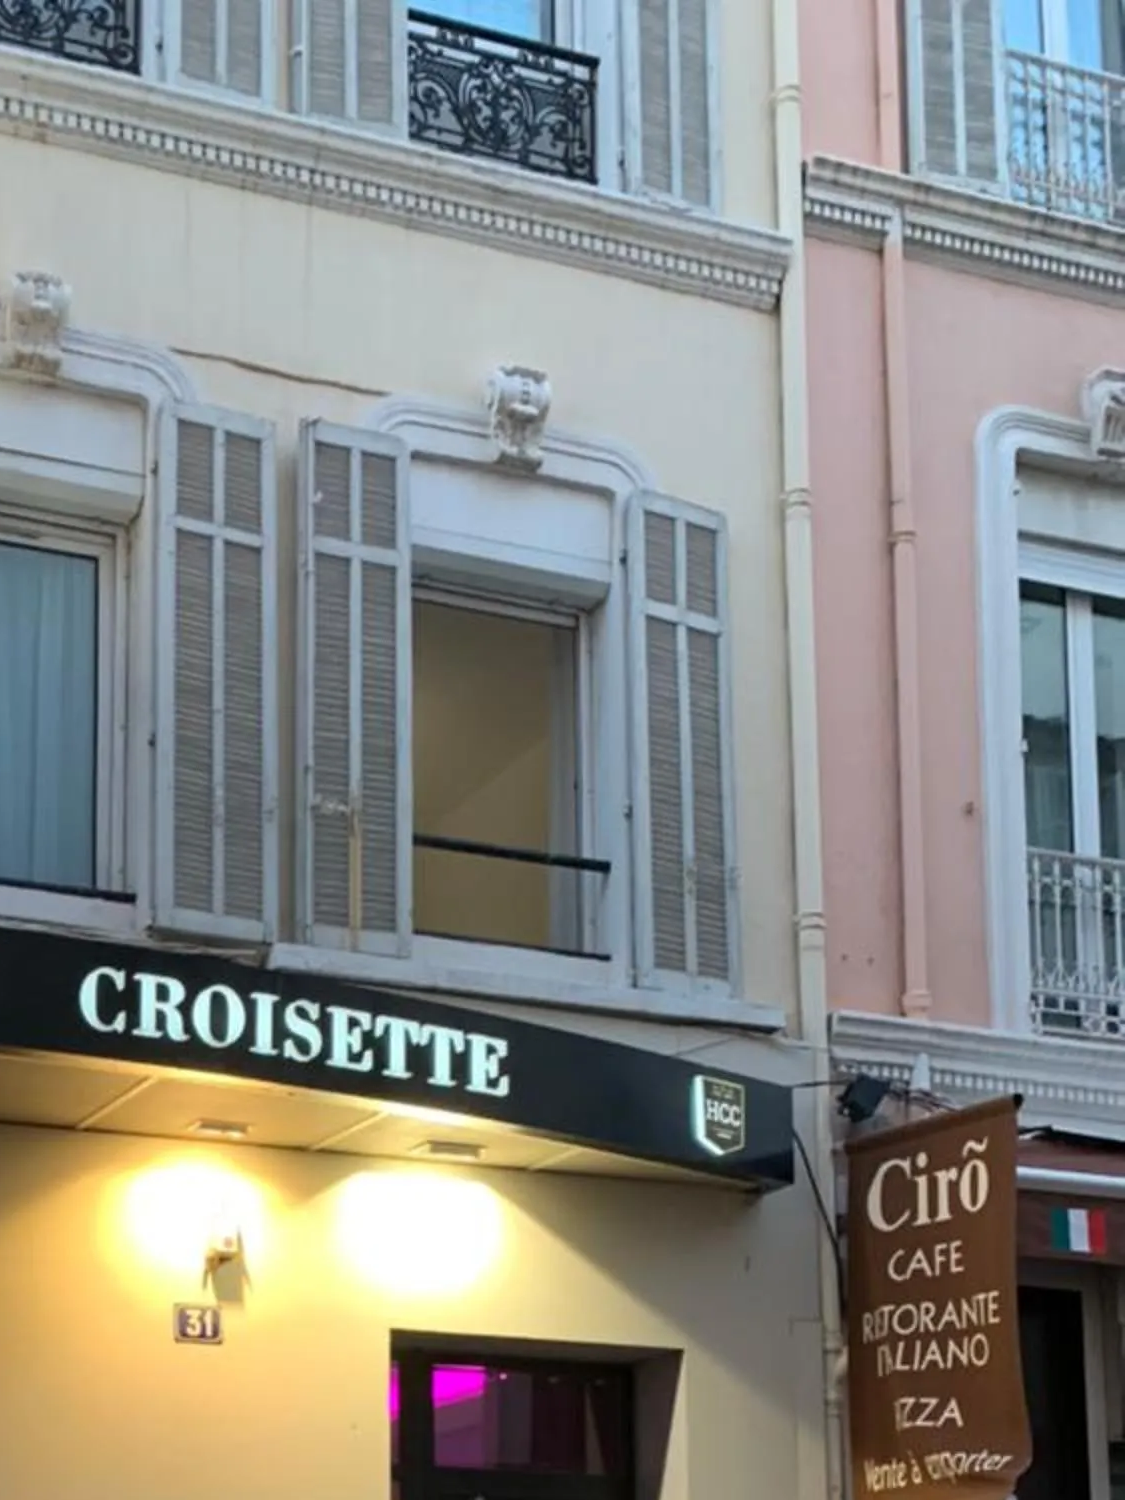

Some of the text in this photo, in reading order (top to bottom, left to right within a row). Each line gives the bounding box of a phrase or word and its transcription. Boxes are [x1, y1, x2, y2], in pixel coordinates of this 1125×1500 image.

[79, 966, 510, 1097] CROISETTE
[887, 1240, 965, 1281] CAFE
[186, 1308, 212, 1337] 31
[864, 1459, 908, 1492] Vente
